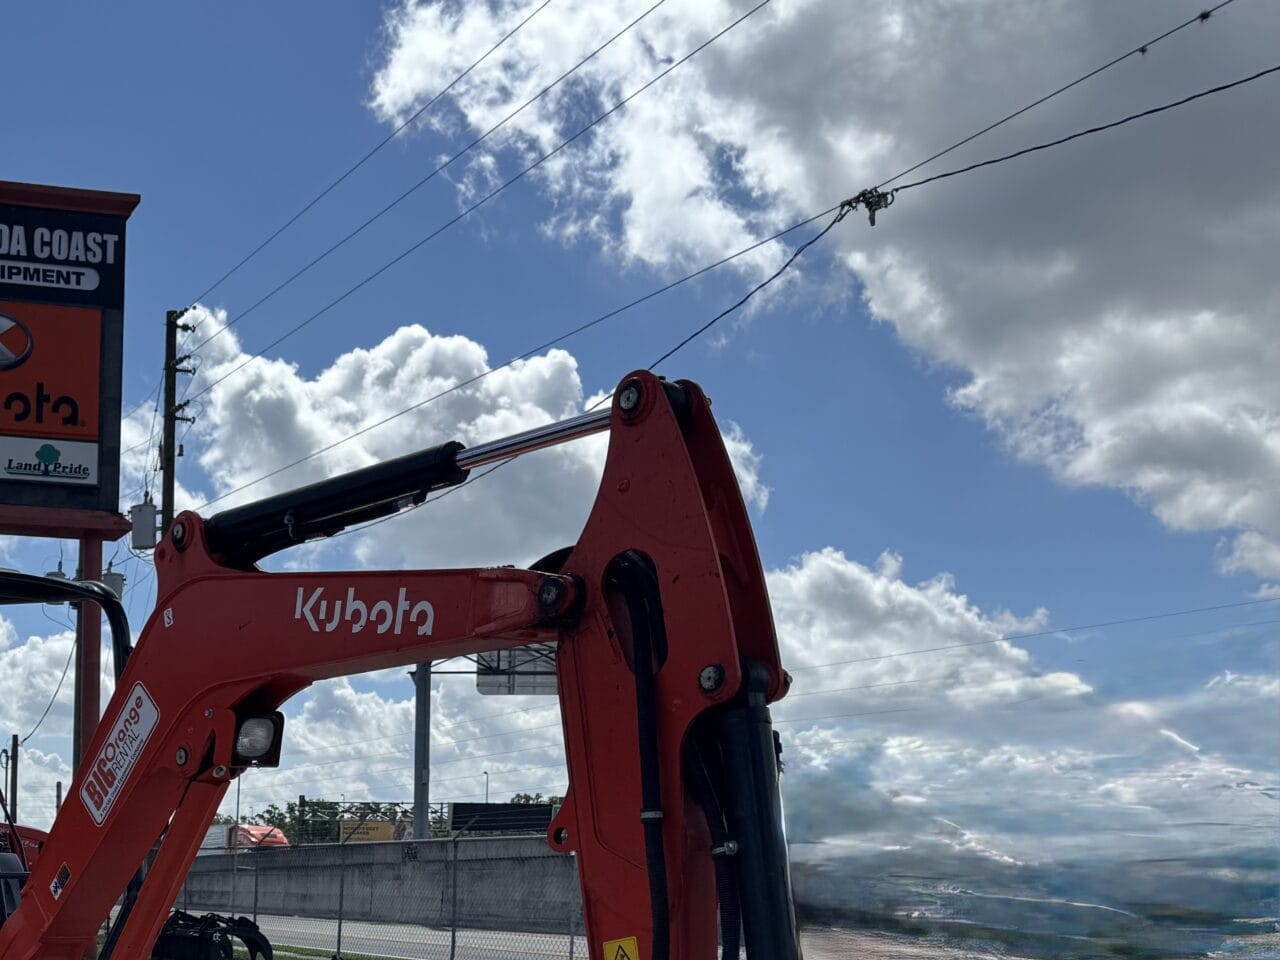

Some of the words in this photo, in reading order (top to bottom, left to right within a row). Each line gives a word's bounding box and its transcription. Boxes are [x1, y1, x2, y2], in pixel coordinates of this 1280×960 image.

[33, 227, 119, 264] COAST
[7, 459, 41, 471] Land
[52, 462, 89, 475] Pride
[295, 587, 435, 636] Kubota
[85, 757, 117, 812] BIG
[104, 695, 144, 763] Orange
[111, 729, 140, 776] RENTAL
